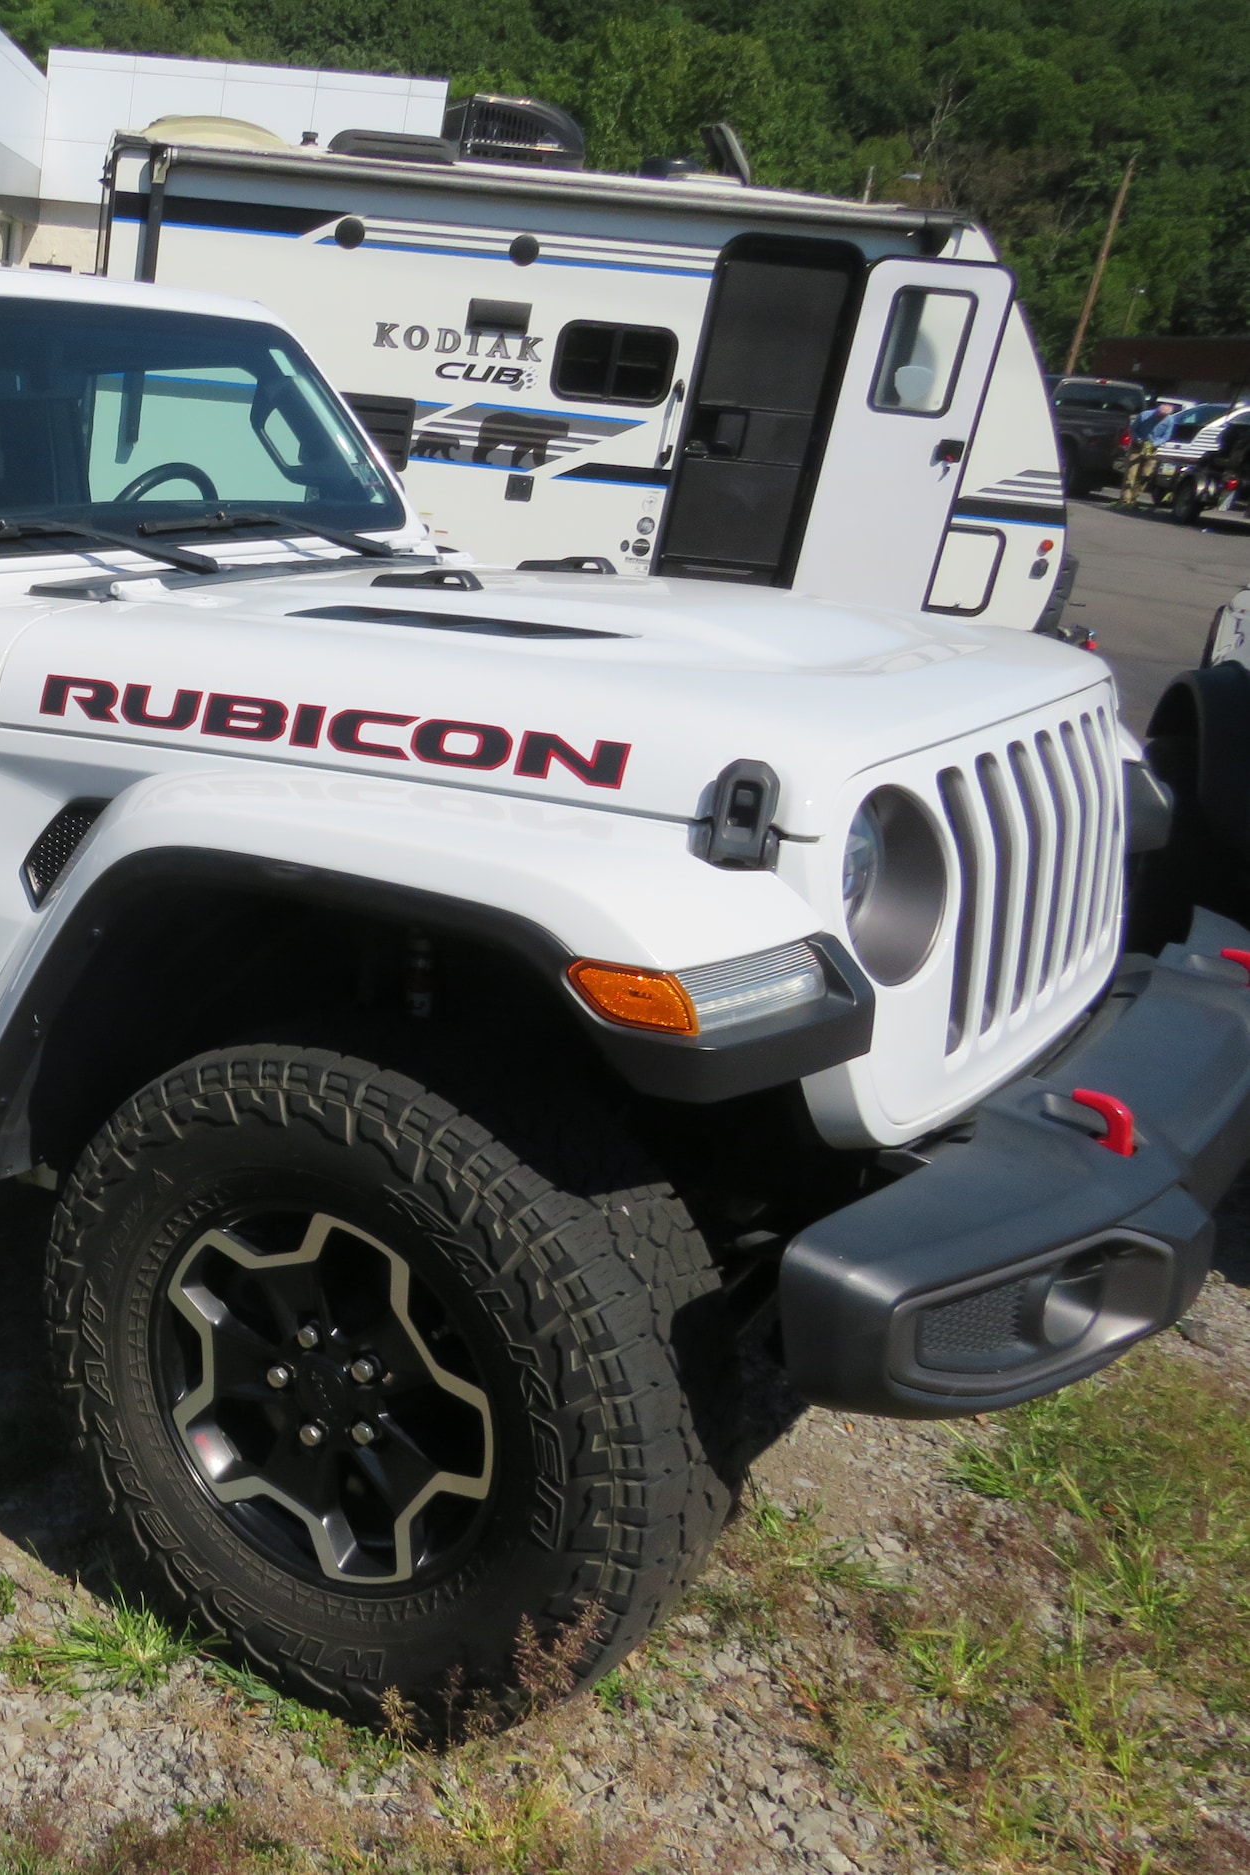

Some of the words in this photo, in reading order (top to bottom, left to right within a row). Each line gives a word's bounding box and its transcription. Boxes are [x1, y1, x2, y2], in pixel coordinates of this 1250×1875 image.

[373, 321, 544, 363] KODIAK
[435, 361, 524, 385] CUB
[39, 674, 632, 790] RUBICON
[384, 1185, 568, 1551] FALKEN
[94, 1411, 387, 1682] WILDPEAK
